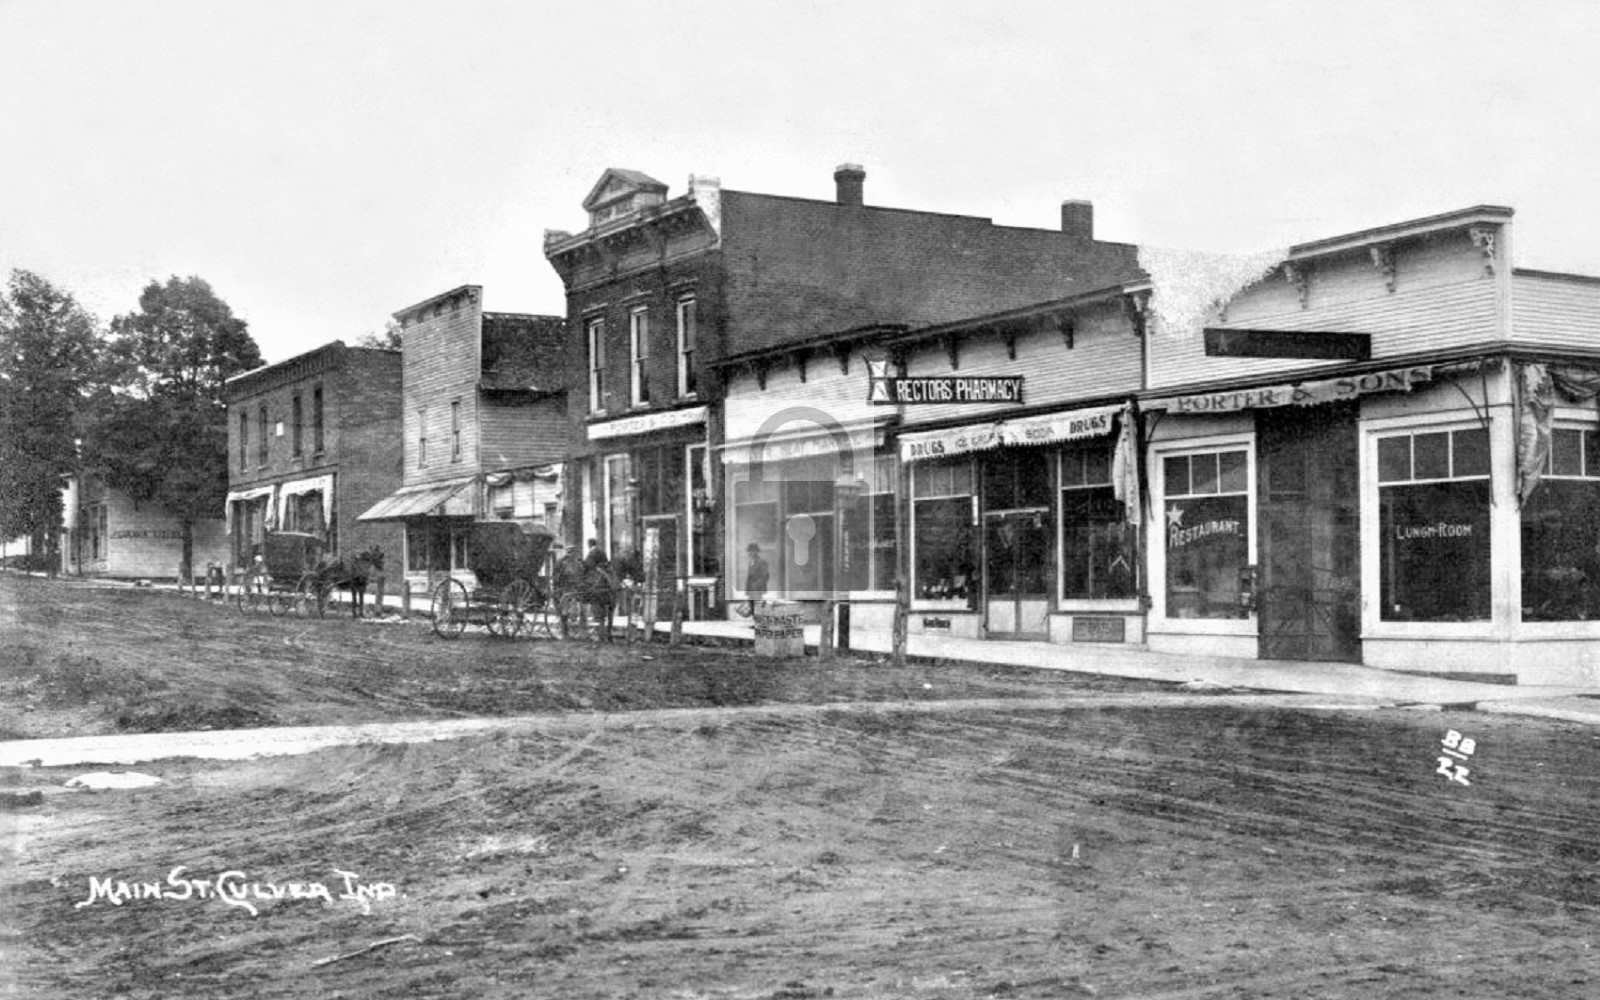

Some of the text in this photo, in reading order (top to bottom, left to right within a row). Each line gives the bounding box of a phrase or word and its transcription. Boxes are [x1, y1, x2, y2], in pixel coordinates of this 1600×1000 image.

[896, 378, 1020, 401] RECTORS PHARMACY
[1177, 367, 1432, 412] PORTER & SONS
[1025, 426, 1054, 440] SODA
[1069, 415, 1107, 434] DRUGS
[910, 440, 945, 456] DRUGS
[1169, 519, 1241, 549] RESTAURANT
